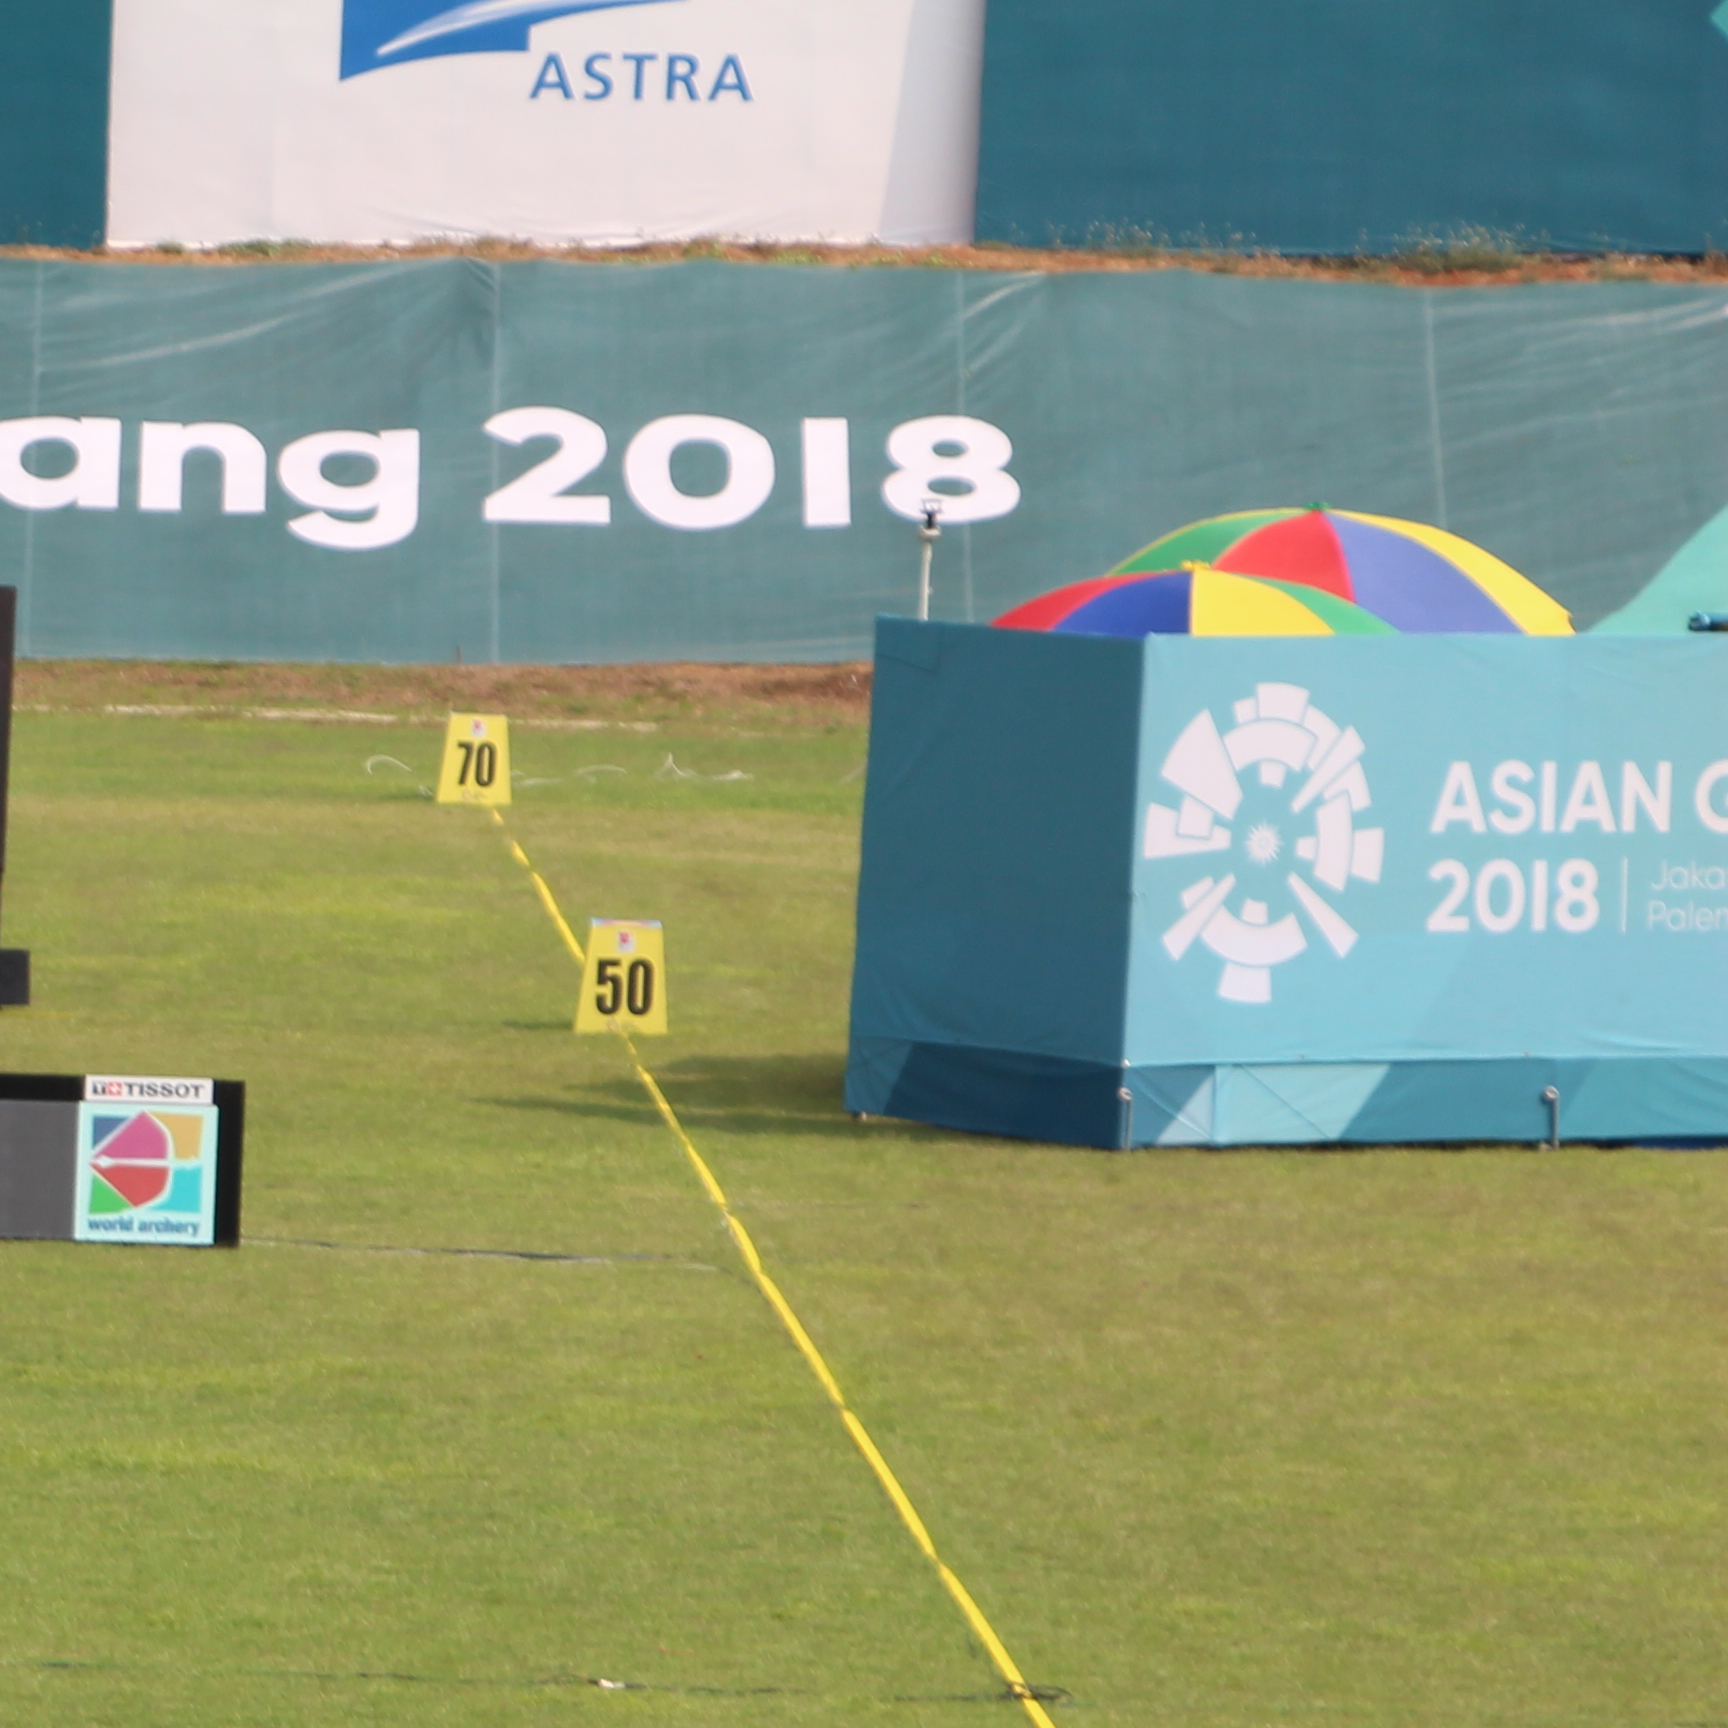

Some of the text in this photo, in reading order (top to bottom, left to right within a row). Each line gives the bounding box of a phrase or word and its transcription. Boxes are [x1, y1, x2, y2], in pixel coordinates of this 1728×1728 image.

[528, 52, 754, 102] ASTRA
[483, 405, 1021, 529] 2018
[457, 740, 497, 787] 70
[1430, 759, 1672, 834] ASIAN
[1426, 858, 1600, 932] 2018
[595, 958, 655, 1016] 50
[124, 1081, 206, 1099] TISSOT
[88, 1215, 199, 1238] world archery
